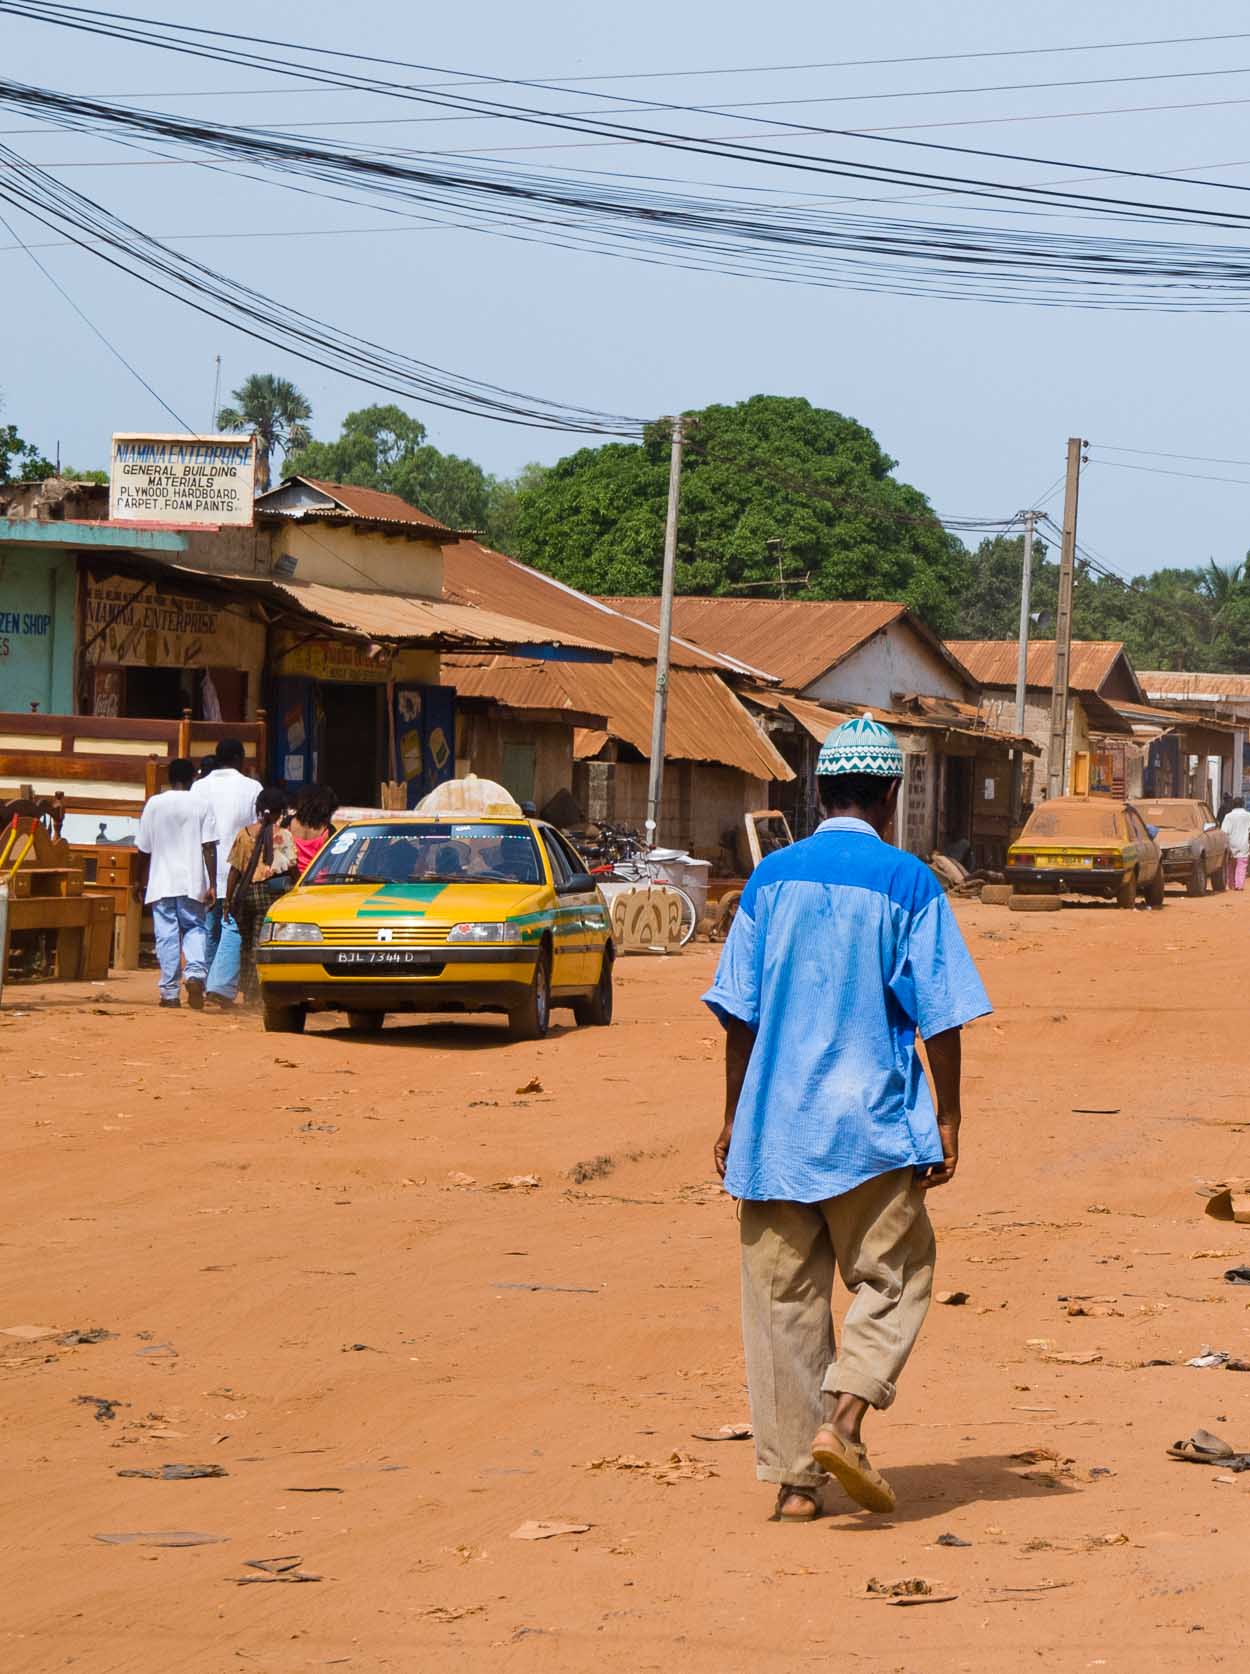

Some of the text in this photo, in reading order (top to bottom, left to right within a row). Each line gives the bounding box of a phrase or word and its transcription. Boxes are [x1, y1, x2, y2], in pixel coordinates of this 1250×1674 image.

[167, 445, 252, 466] ENTERPRISE
[122, 464, 238, 478] GENERAL BUILDING
[147, 477, 214, 489] MATERIALS
[23, 613, 51, 636] SHOP
[144, 607, 218, 634] ENTERPRISE
[338, 952, 414, 963] BJL 7344 D
